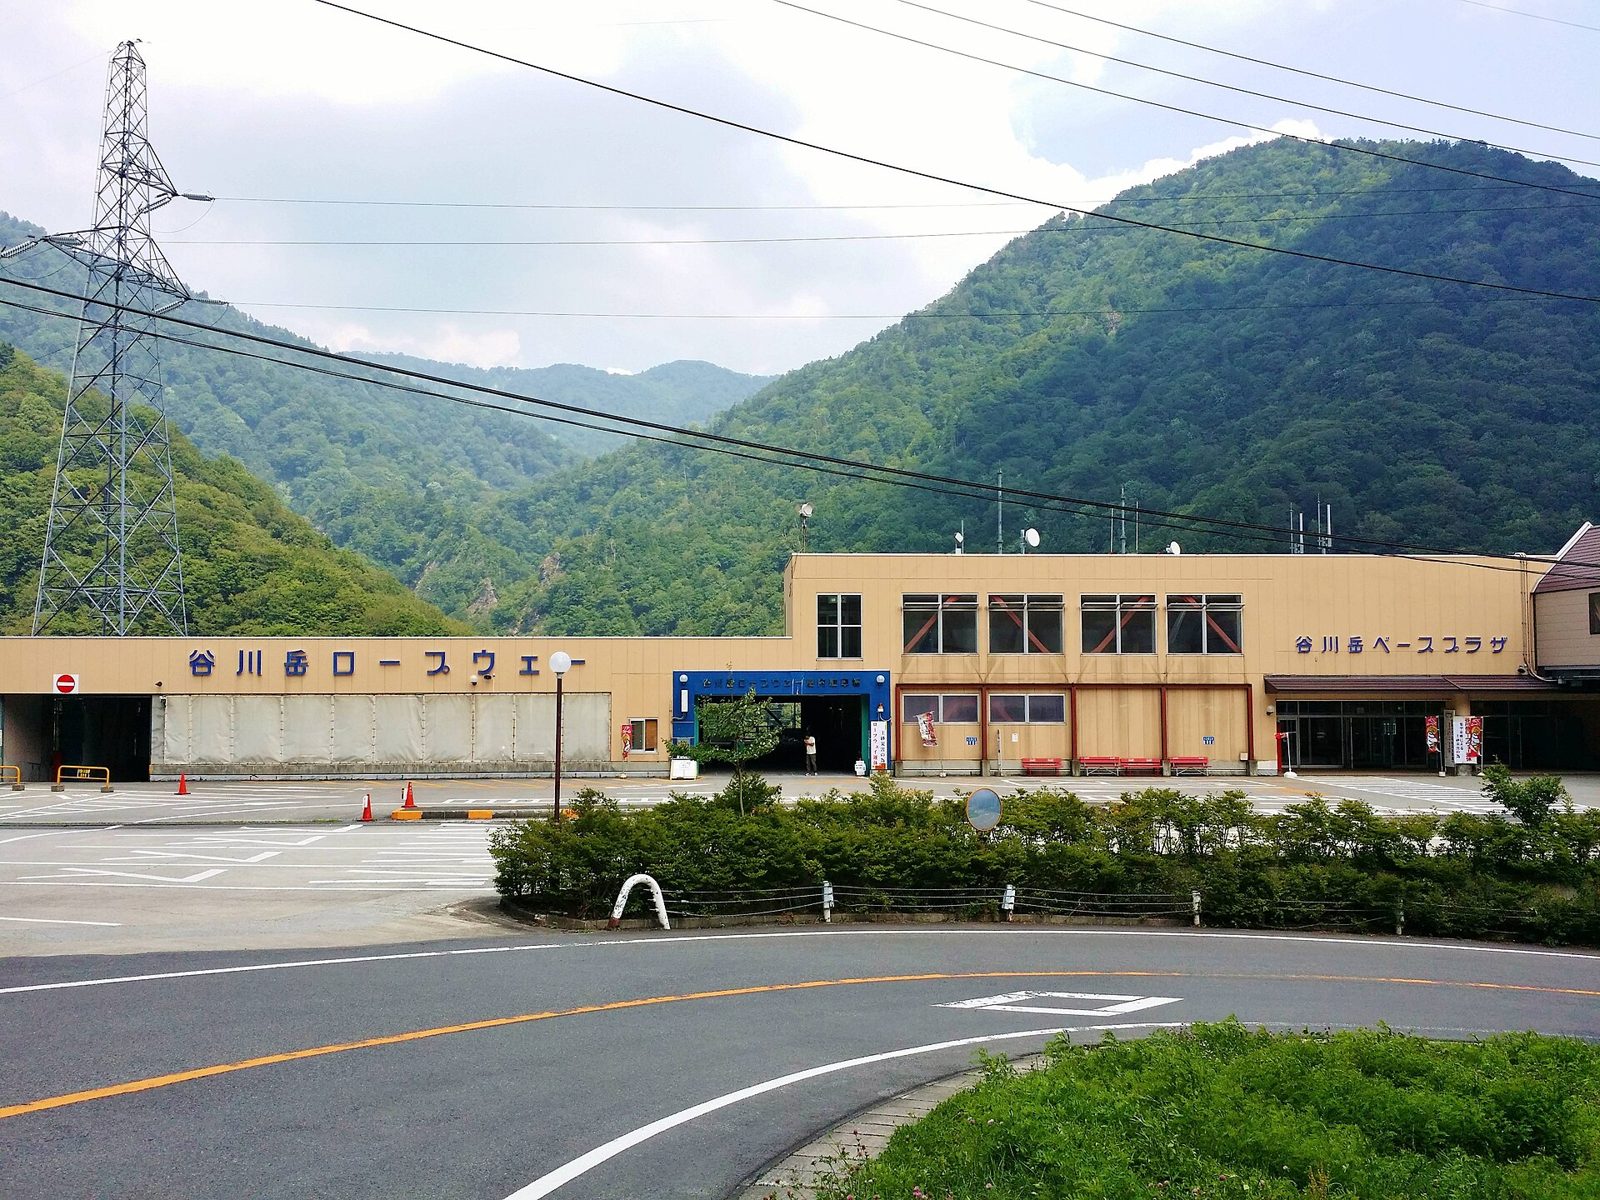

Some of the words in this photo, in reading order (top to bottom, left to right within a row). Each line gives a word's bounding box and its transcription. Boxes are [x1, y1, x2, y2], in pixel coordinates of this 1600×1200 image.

[1296, 635, 1508, 654] 谷川岳ベースプラザ
